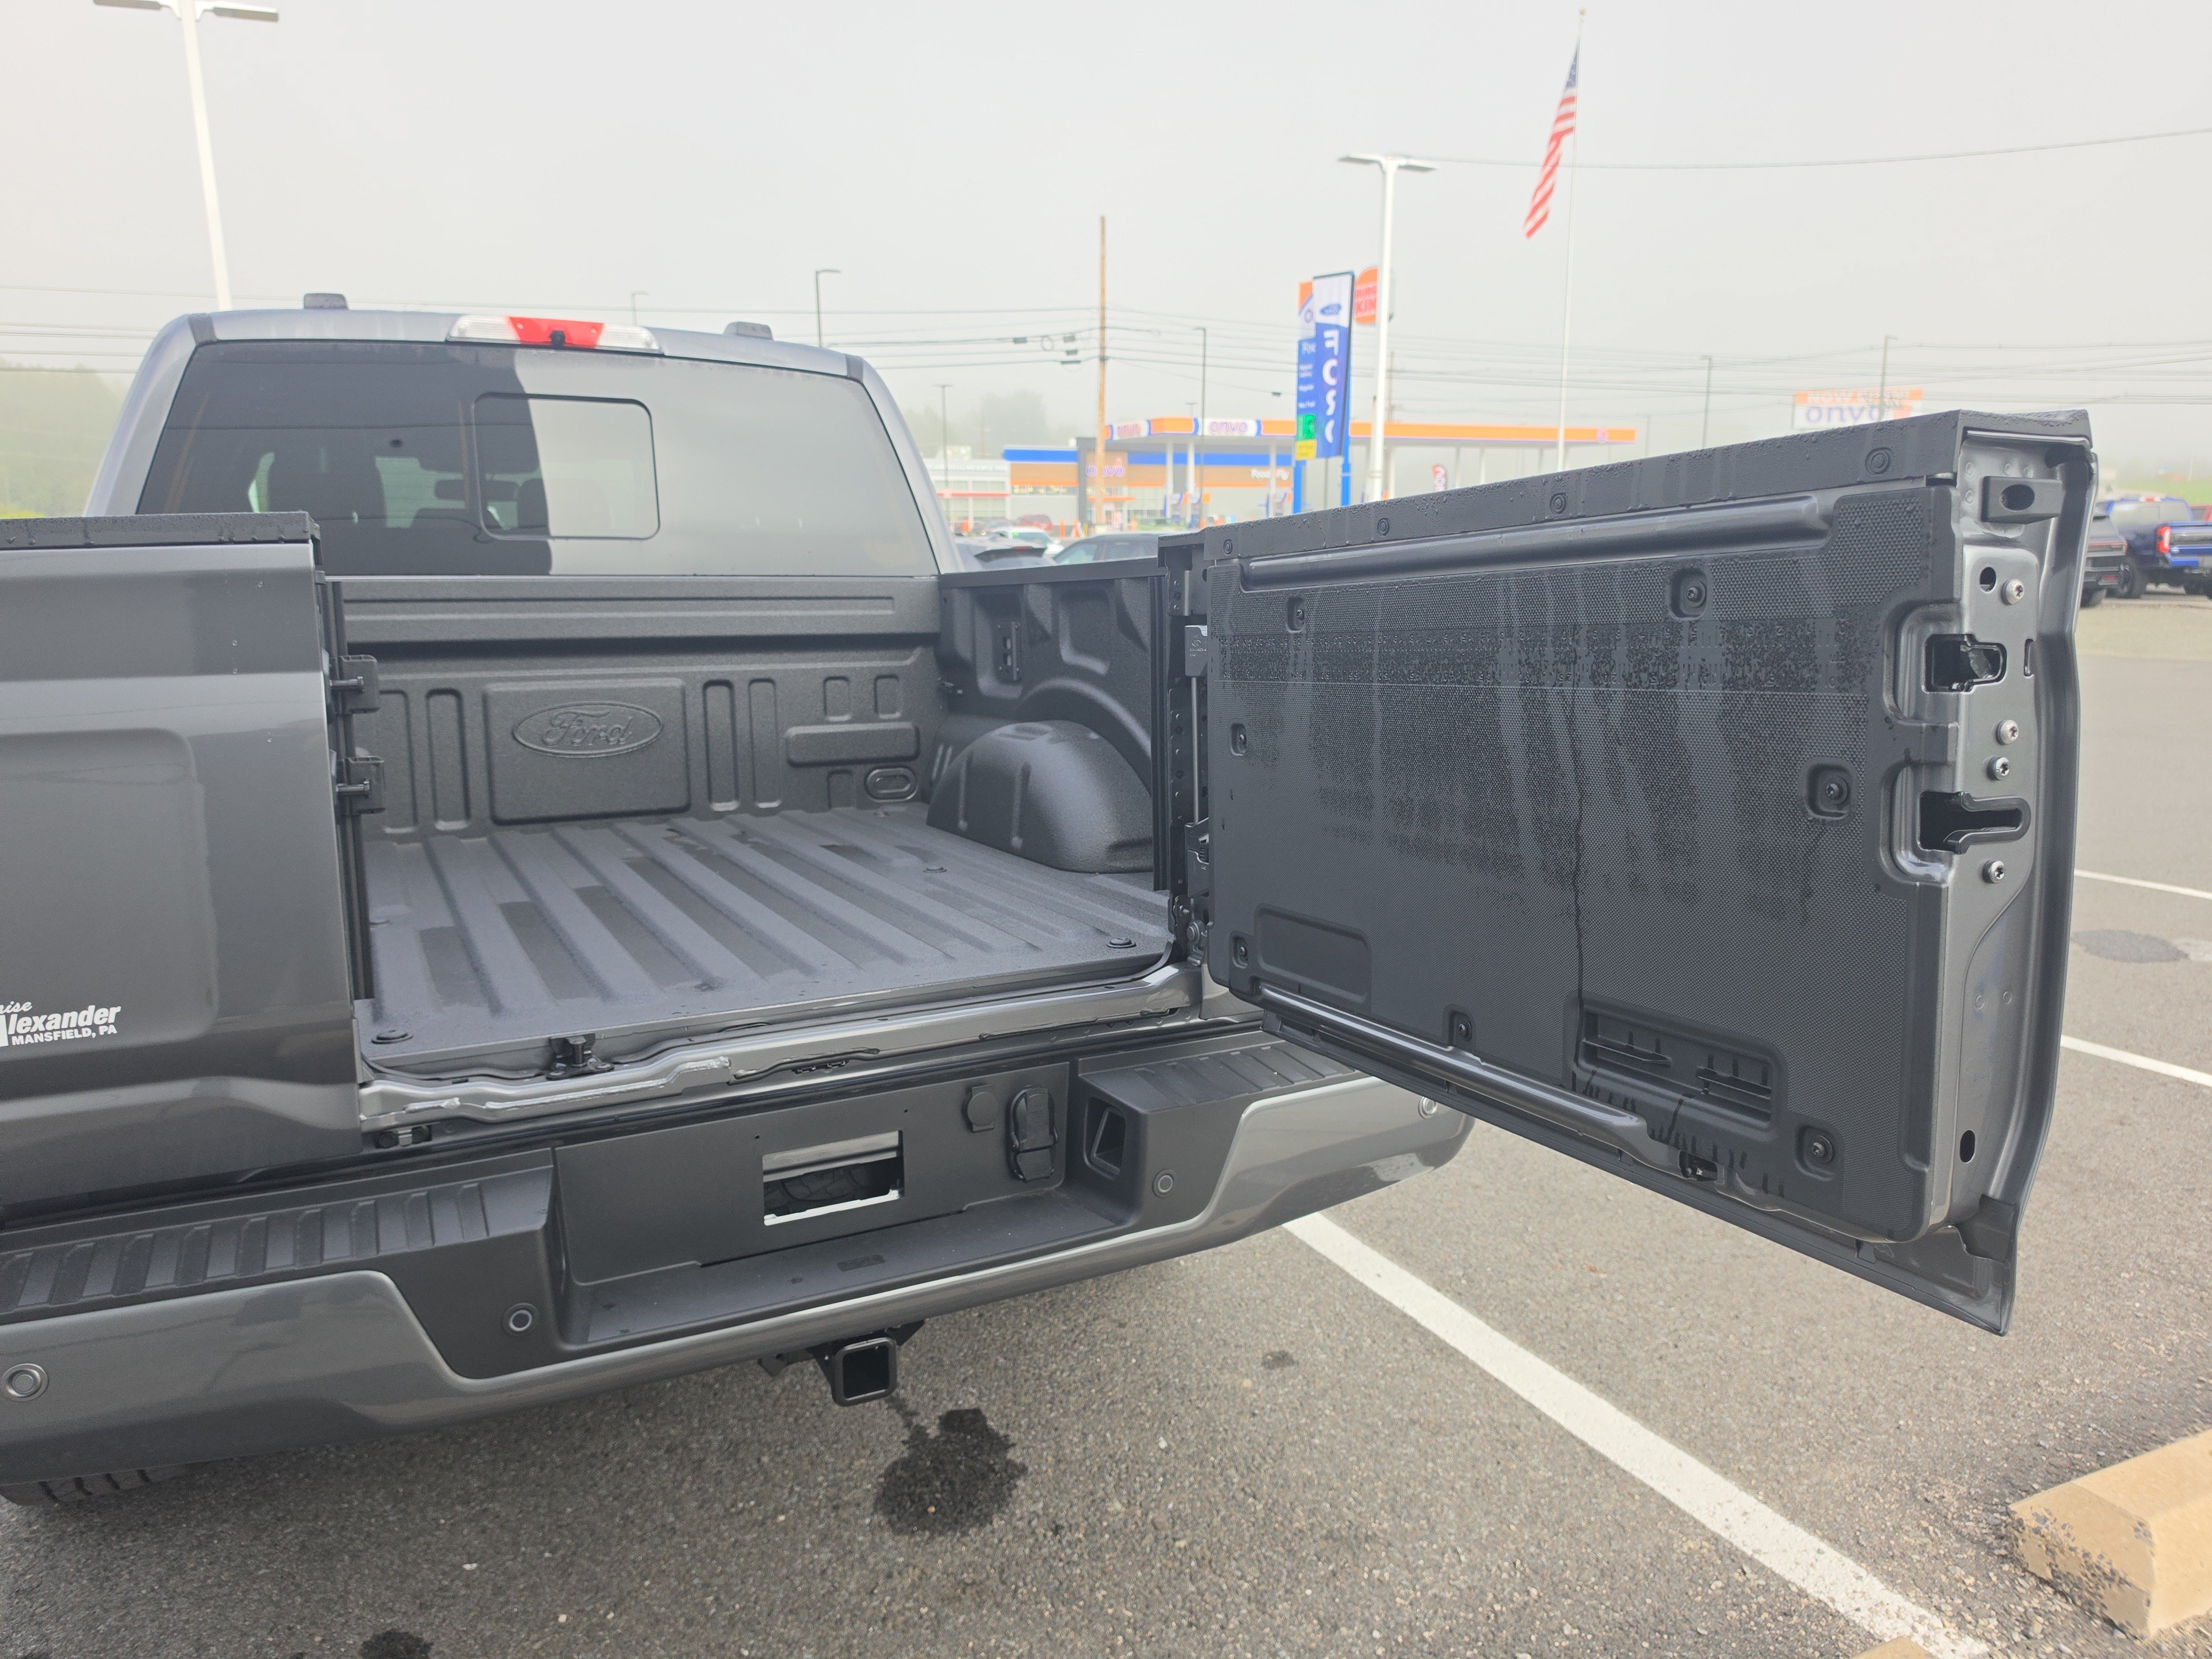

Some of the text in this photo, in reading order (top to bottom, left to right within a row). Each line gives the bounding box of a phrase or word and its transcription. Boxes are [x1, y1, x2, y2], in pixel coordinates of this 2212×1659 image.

[1210, 421, 1248, 433] onvo
[542, 711, 634, 747] Ford
[11, 1025, 117, 1045] MANSFIELD, PA
